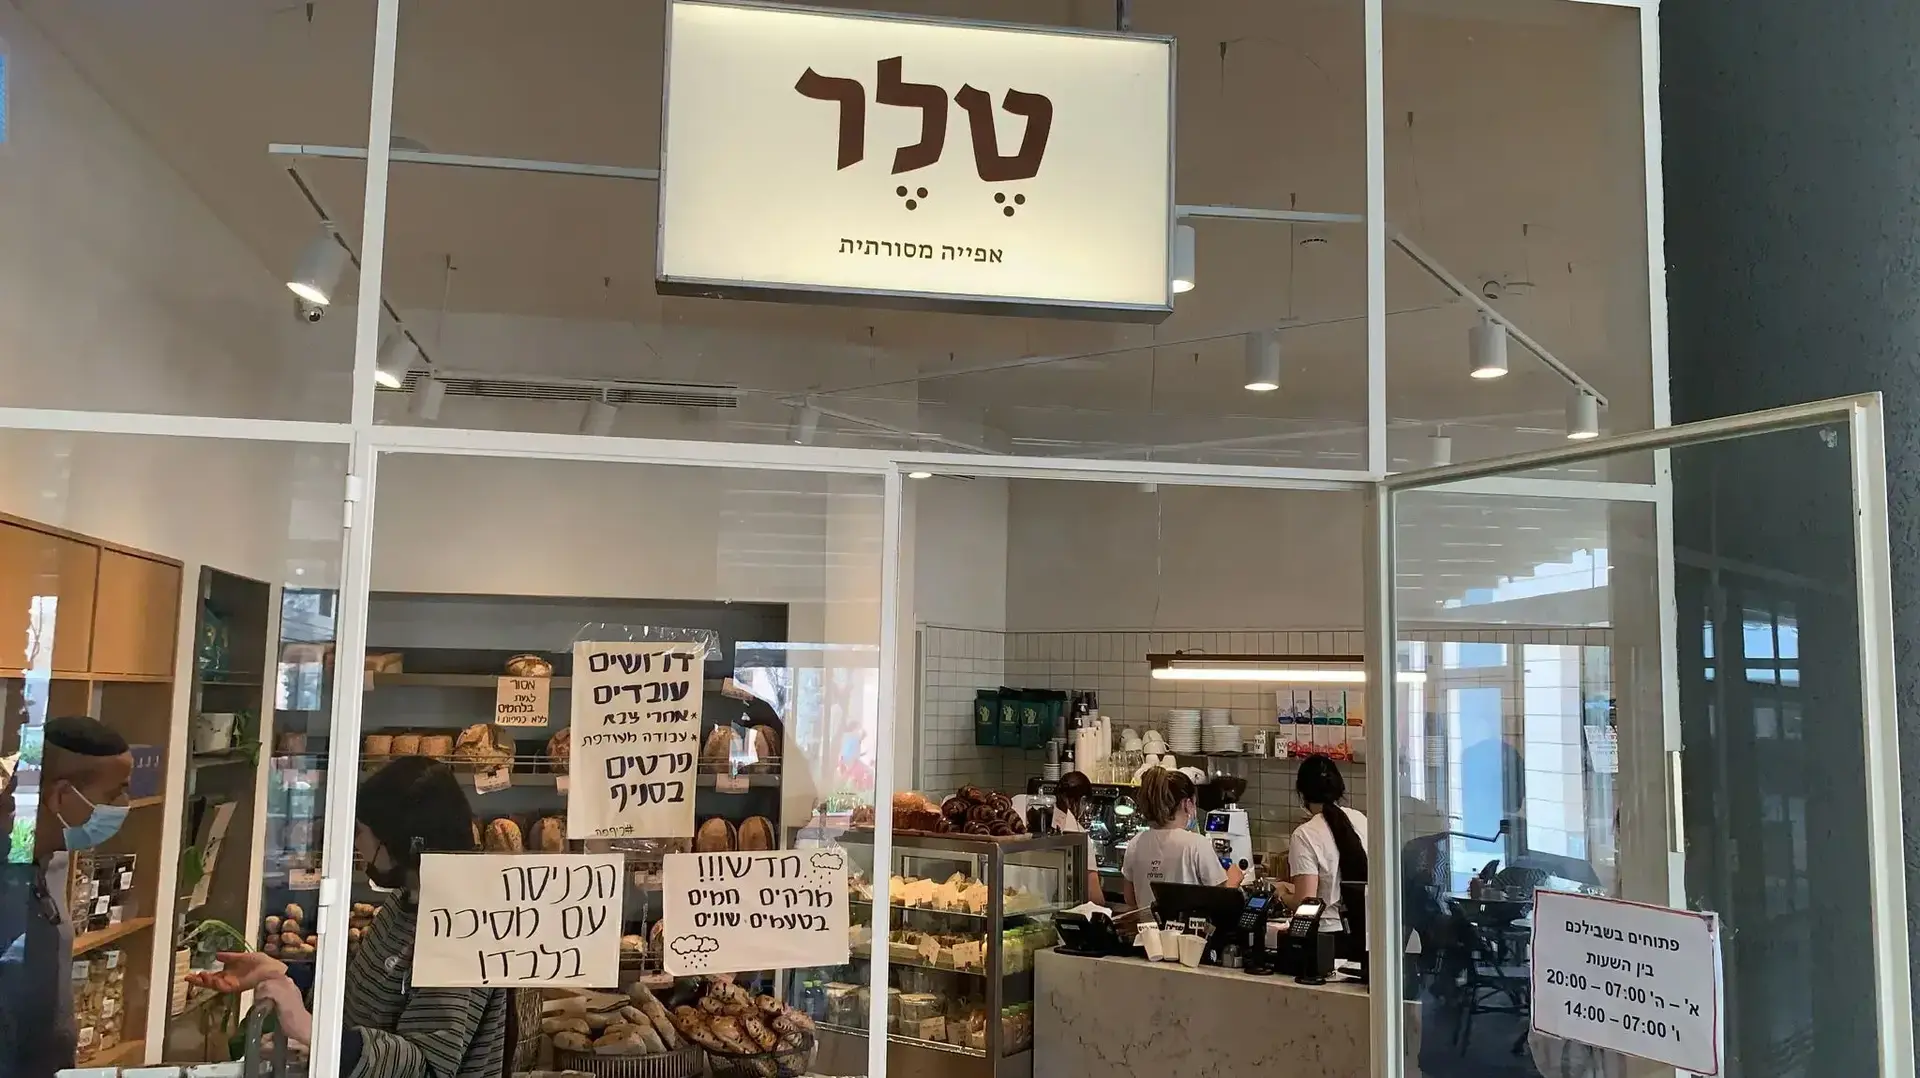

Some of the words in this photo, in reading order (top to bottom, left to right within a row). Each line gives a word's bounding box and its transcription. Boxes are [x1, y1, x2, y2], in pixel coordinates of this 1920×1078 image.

[838, 237, 933, 259] מסורתית
[941, 244, 1003, 263] אפייה
[588, 651, 695, 675] דרושים
[509, 679, 536, 690] אסור
[593, 680, 690, 705] עובדים
[497, 702, 535, 714] בלחמים
[602, 711, 640, 726] צבא
[642, 731, 687, 743] עבודה
[605, 752, 693, 780] פרטים
[610, 781, 685, 813] בסניף
[698, 855, 801, 883] חדש!!!
[501, 864, 616, 904] הכניסה
[687, 888, 740, 906] חמים
[759, 884, 833, 909] מרקים
[429, 906, 540, 941] מסיכה
[561, 905, 607, 940] עם
[694, 912, 741, 928] שונים
[749, 912, 830, 932] בטעמים
[1565, 919, 1624, 942] בשבילכם
[1628, 932, 1680, 952] פתוחים
[478, 943, 586, 985] בלבד!
[1585, 952, 1631, 972] השעות
[1636, 962, 1654, 978] בין
[1546, 968, 1587, 991] 20:00
[1605, 981, 1646, 1004] 07:00
[1650, 990, 1665, 1009] ה'
[1564, 1000, 1605, 1023] 14:00
[1684, 998, 1700, 1017] א'
[1623, 1014, 1667, 1038] 07:00
